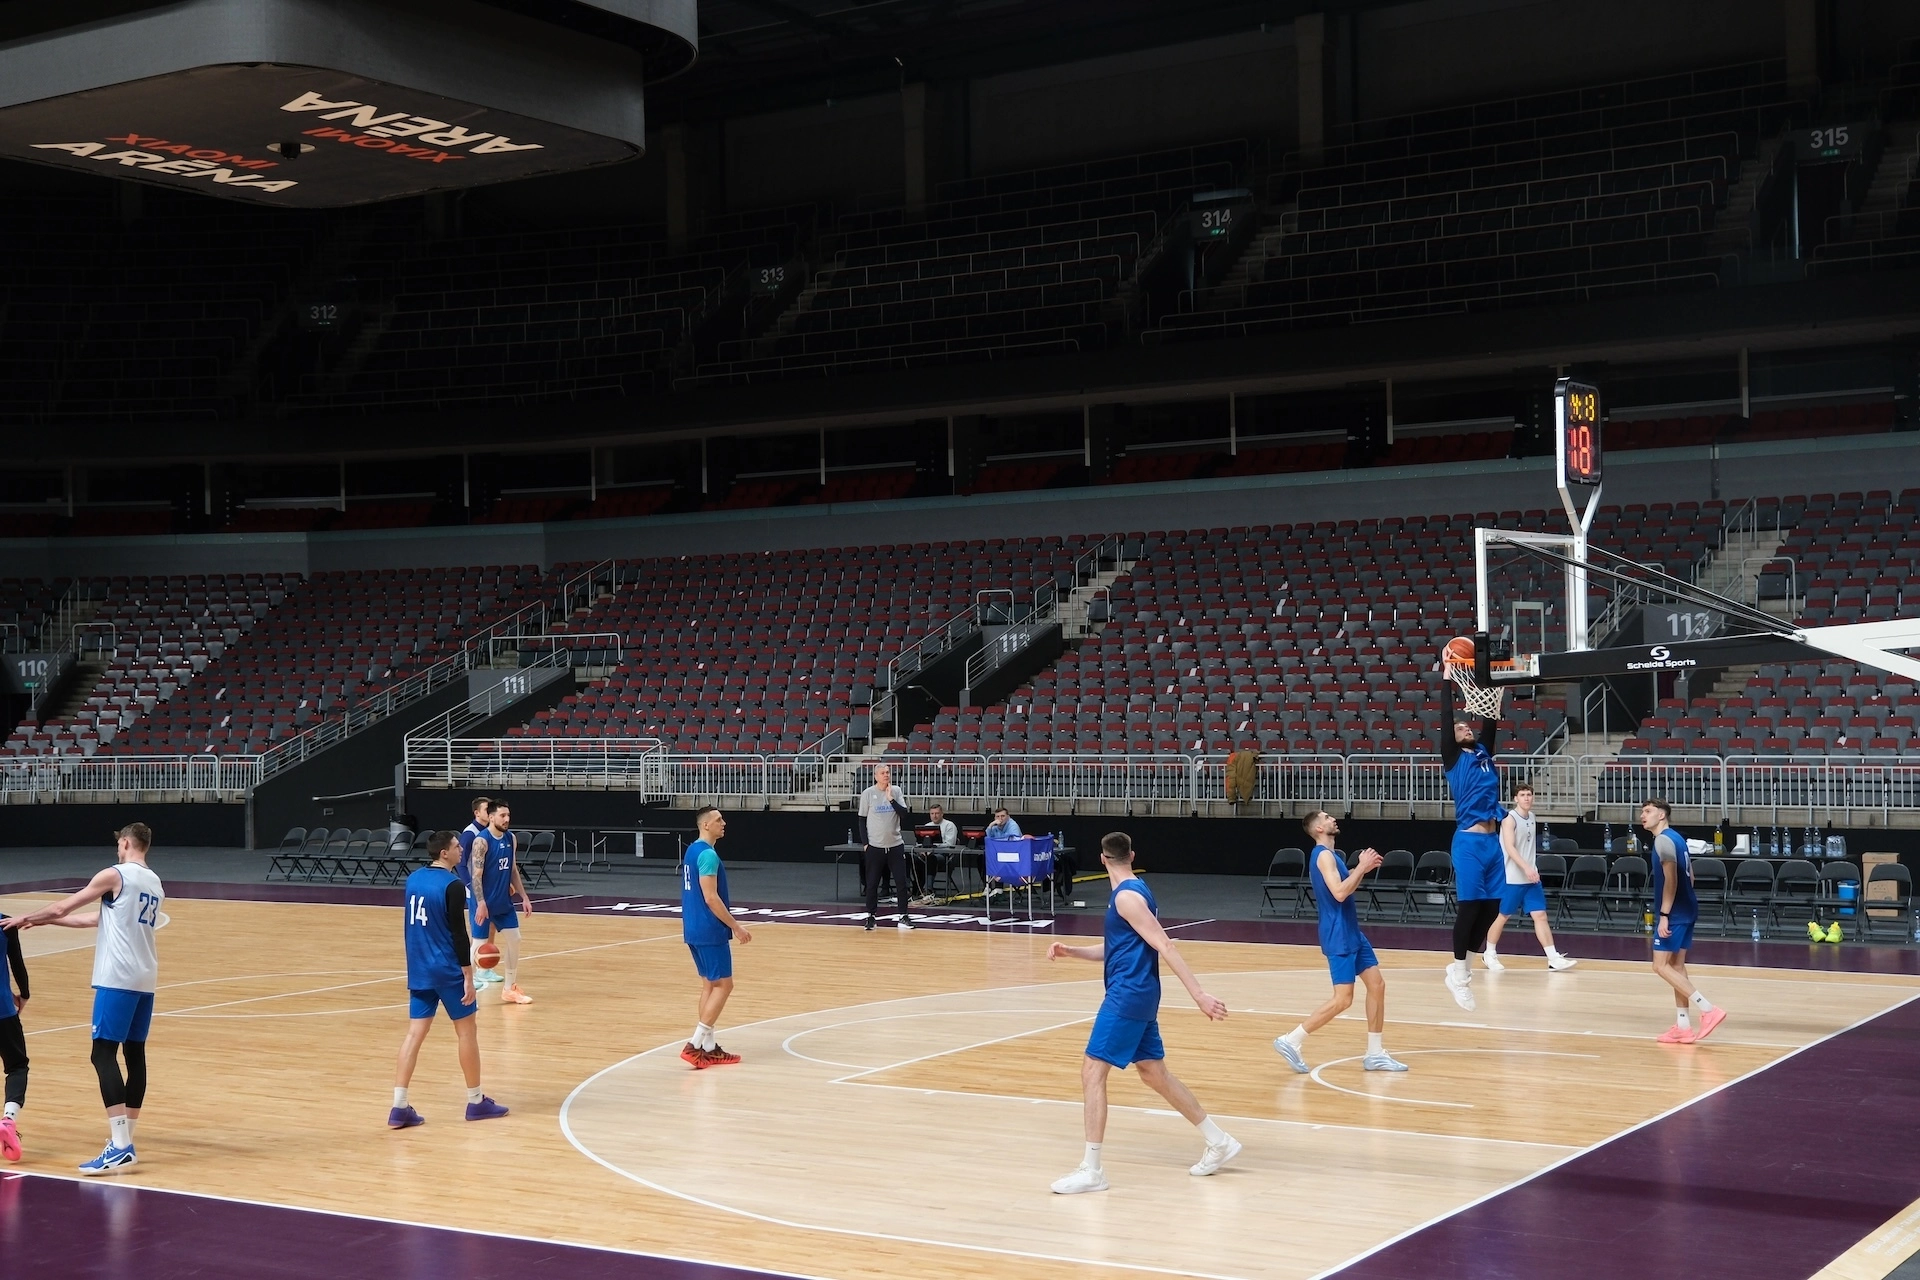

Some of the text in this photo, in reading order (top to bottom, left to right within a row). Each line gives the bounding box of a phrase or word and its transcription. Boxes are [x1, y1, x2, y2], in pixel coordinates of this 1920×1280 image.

[301, 127, 466, 163] XIAOMI
[1810, 126, 1849, 149] 315
[105, 133, 279, 169] XIAOMI
[1201, 209, 1231, 228] 314
[760, 266, 785, 284] 313
[310, 305, 338, 319] 312
[1570, 426, 1591, 475] 18
[1666, 612, 1710, 637] 113
[17, 660, 48, 676] 110
[1626, 659, 1697, 670] Schelde Sports
[502, 676, 525, 694] 111
[498, 857, 510, 871] 32
[138, 892, 159, 928] 23
[409, 894, 428, 926] 14
